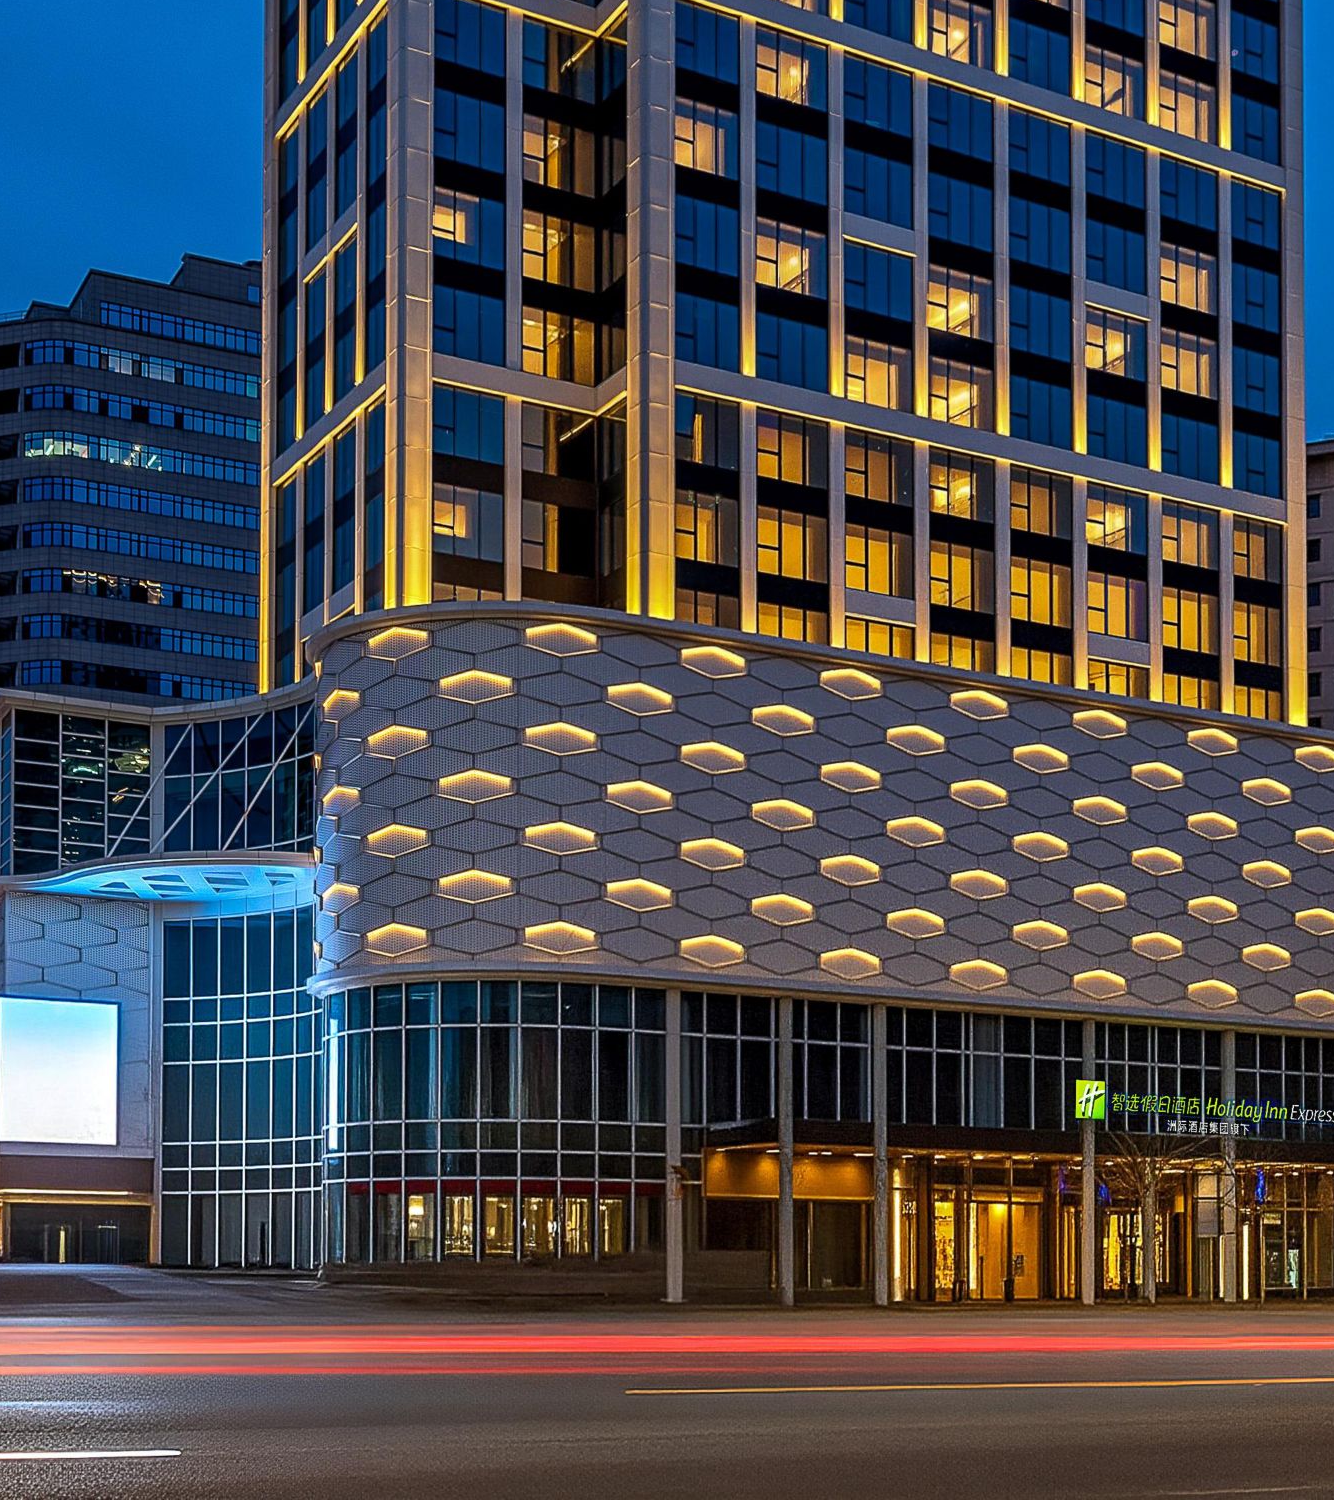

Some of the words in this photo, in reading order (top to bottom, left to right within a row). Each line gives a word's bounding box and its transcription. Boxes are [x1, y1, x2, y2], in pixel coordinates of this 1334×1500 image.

[1111, 1092, 1201, 1115] 智选假日酒店
[1206, 1097, 1263, 1123] Holiday
[1264, 1100, 1288, 1120] Inn
[1167, 1119, 1250, 1136] 洲际酒店集团旗下
